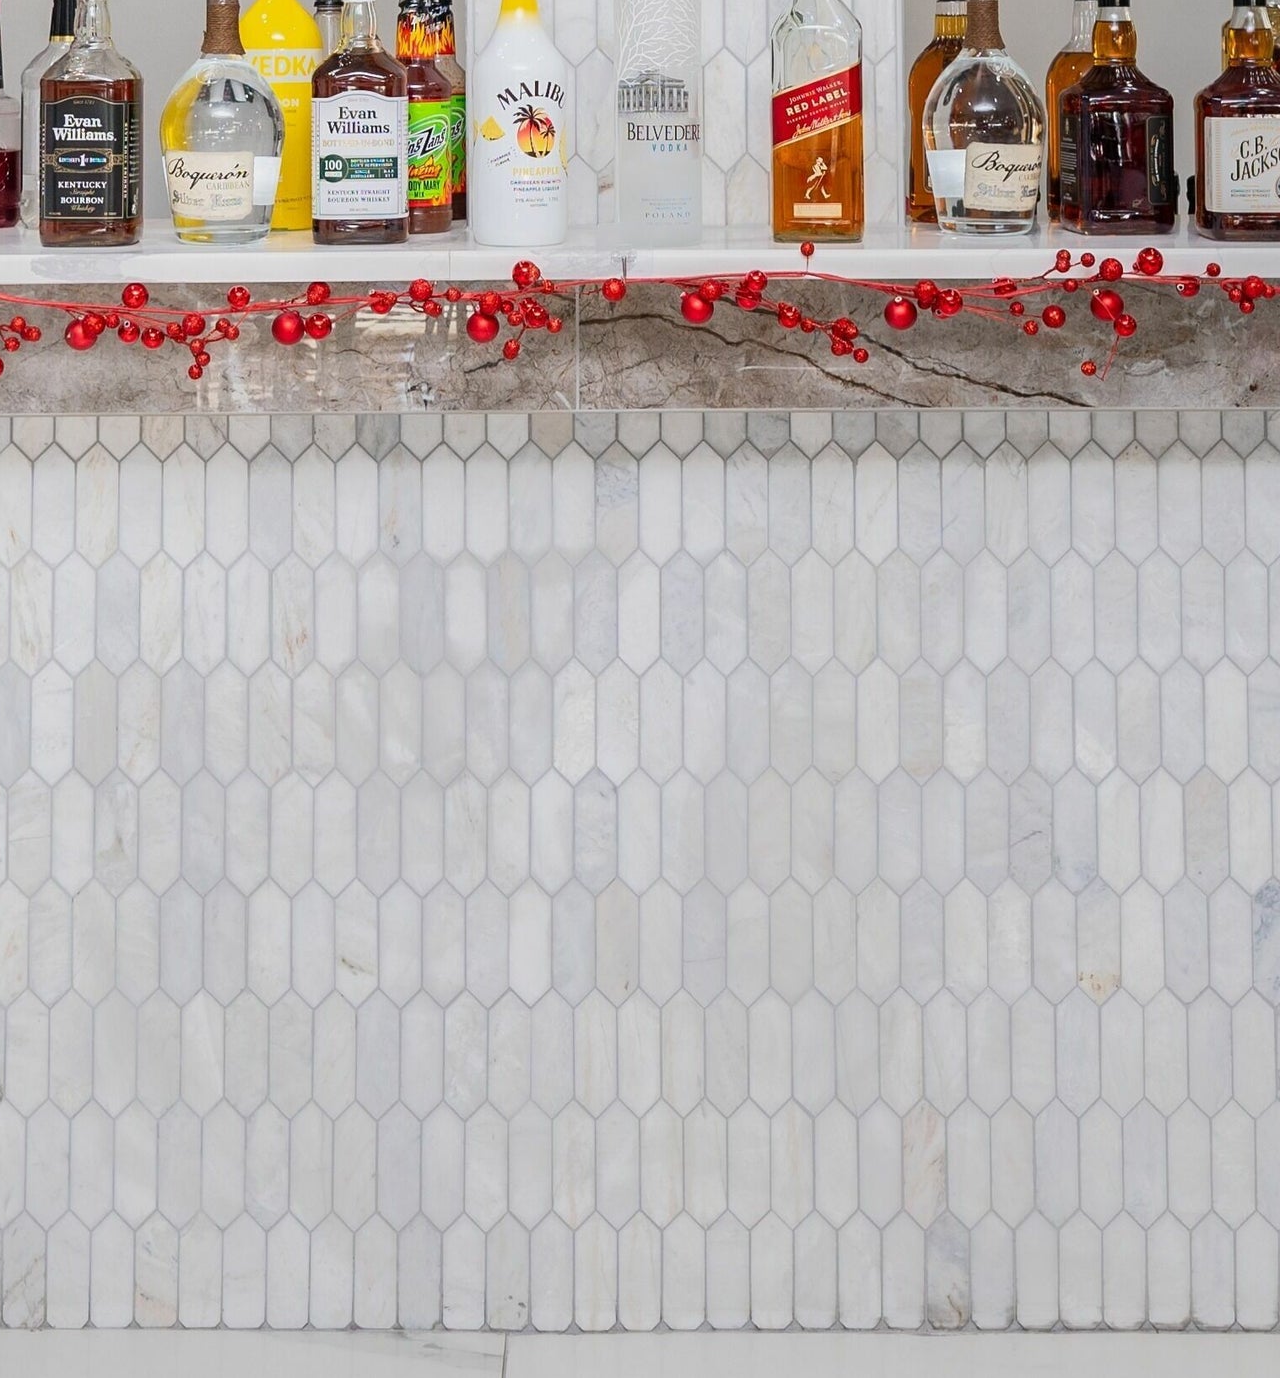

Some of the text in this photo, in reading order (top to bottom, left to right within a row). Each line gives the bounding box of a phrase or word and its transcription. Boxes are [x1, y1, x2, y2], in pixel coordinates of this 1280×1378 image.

[251, 56, 319, 76] EDKA
[496, 80, 567, 111] MALIBU
[785, 87, 848, 117] RED LABEL
[789, 89, 815, 104] JOHNNIE
[338, 106, 378, 120] Evan
[63, 113, 102, 128] Evan
[652, 143, 688, 152] VODKA
[1239, 135, 1268, 159] C.B.
[324, 159, 343, 171] 100
[512, 167, 560, 176] PINEAPPLE
[167, 157, 250, 190] Boquerón
[58, 181, 107, 189] KENTUCKY
[206, 181, 250, 190] CARIBBEAN
[423, 180, 441, 190] MARY
[60, 196, 104, 204] BOURBON
